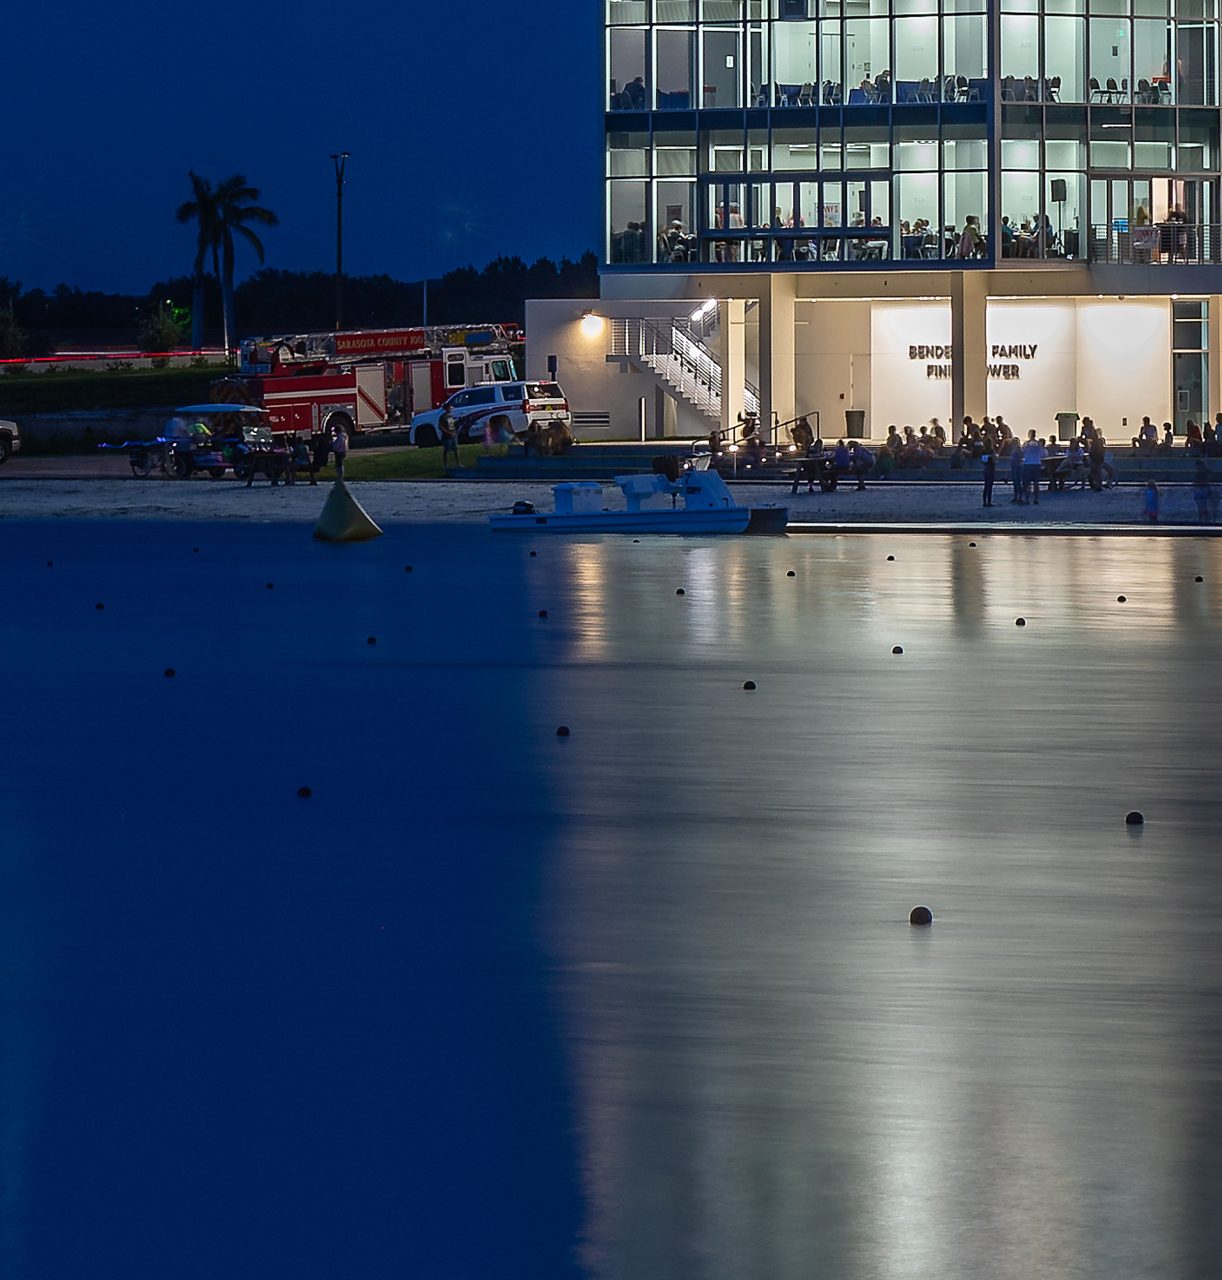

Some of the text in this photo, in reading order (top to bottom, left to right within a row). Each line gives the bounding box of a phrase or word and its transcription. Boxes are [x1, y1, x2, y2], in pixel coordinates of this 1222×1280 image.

[337, 338, 375, 350] SARASOTA
[377, 336, 408, 347] COUNTY
[908, 344, 1038, 360] BENDE FAMILY
[926, 364, 1020, 380] FINI WER
